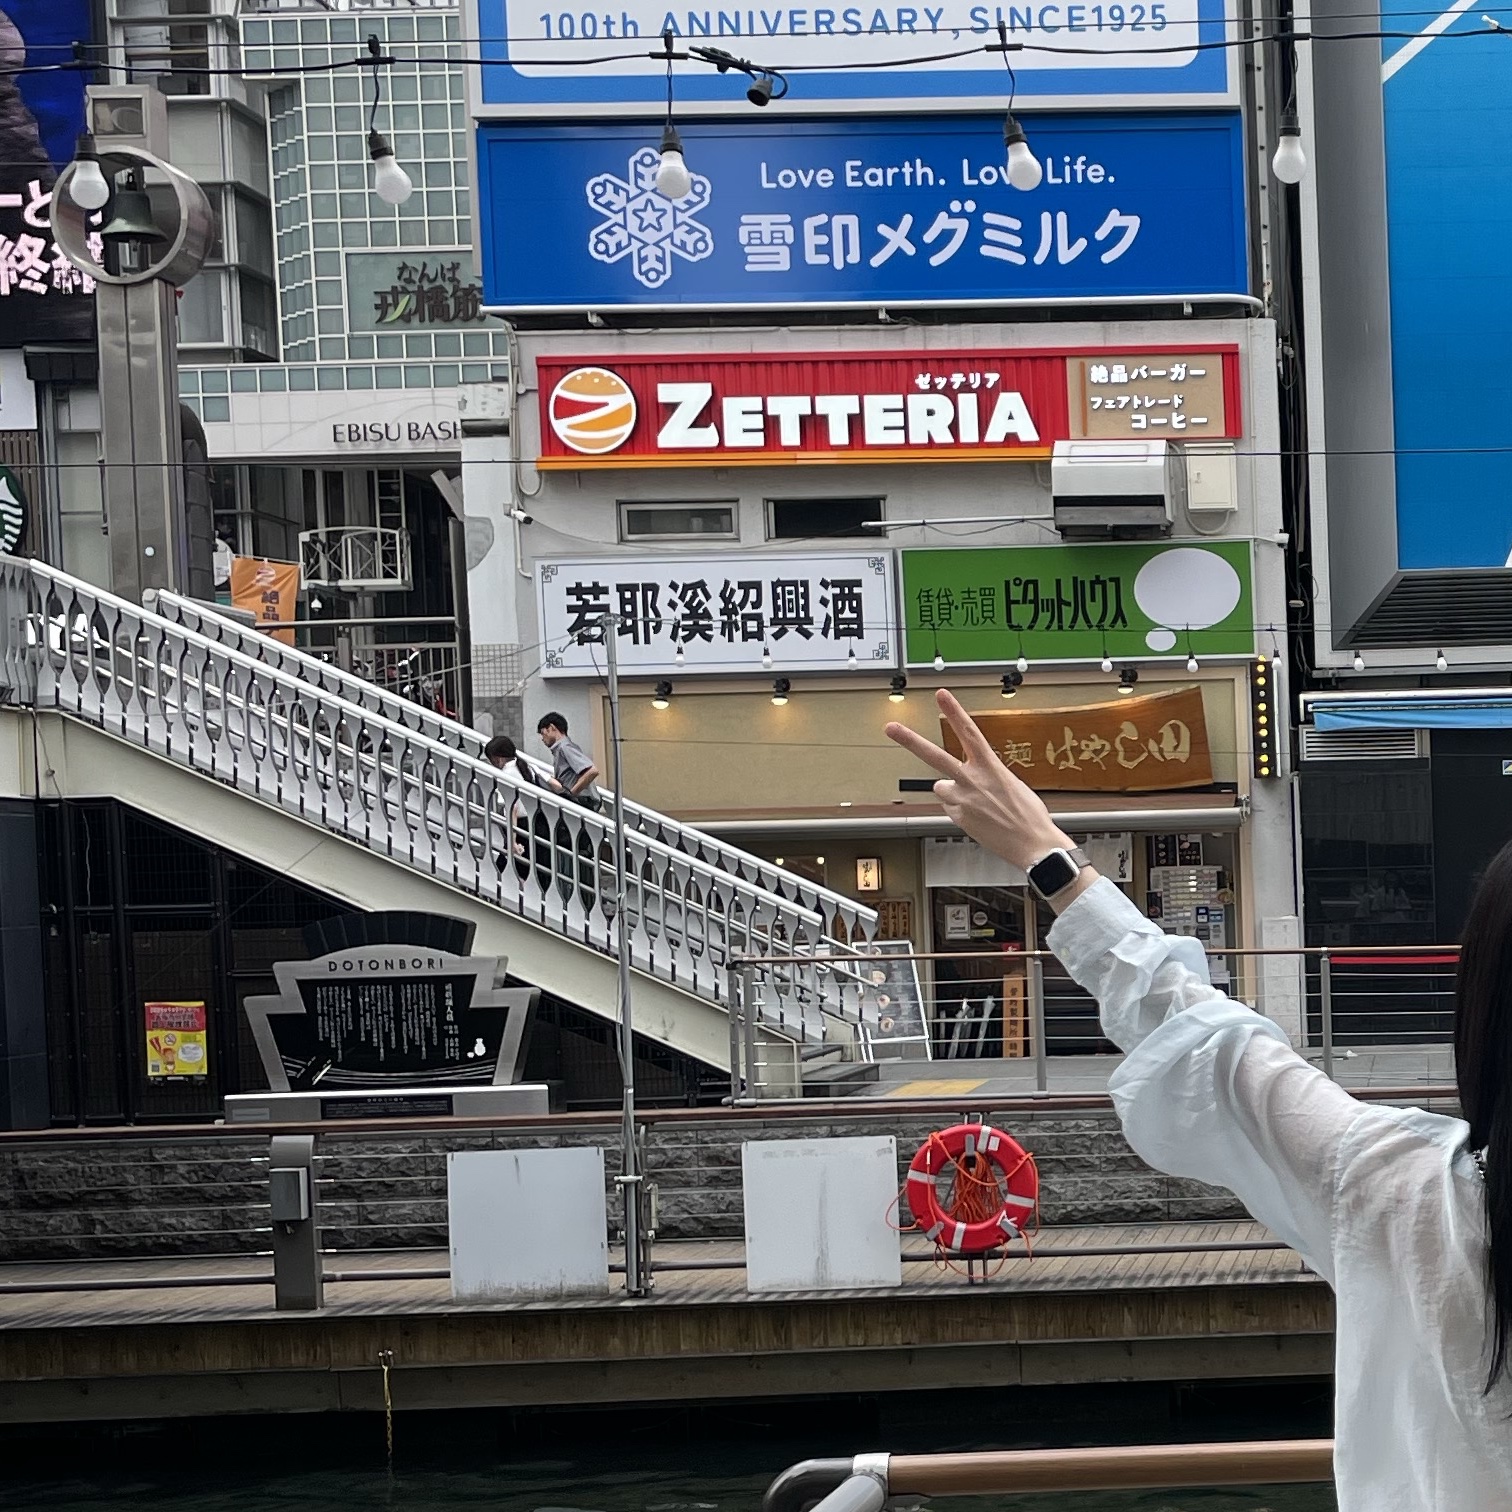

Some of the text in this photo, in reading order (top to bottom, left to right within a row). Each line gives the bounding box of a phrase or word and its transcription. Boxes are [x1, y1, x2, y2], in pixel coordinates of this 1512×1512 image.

[539, 11, 639, 40] 100th
[760, 160, 835, 189] Love
[845, 157, 946, 188] Earth.
[1046, 155, 1115, 184] Life.
[738, 199, 1141, 272] 雪印メグミルク
[397, 261, 461, 284] なんば
[914, 371, 1000, 390] ゼッテリア
[1090, 363, 1206, 384] 絶品バーガー
[1090, 394, 1184, 410] フェアトレード
[656, 381, 1041, 449] ZETTERIA
[1131, 413, 1208, 430] コーヒー
[332, 422, 401, 444] EBISU
[916, 587, 997, 627] 賃貸・売買
[1003, 574, 1128, 632] ピタットハウス
[328, 957, 445, 972] DOTONBORI
